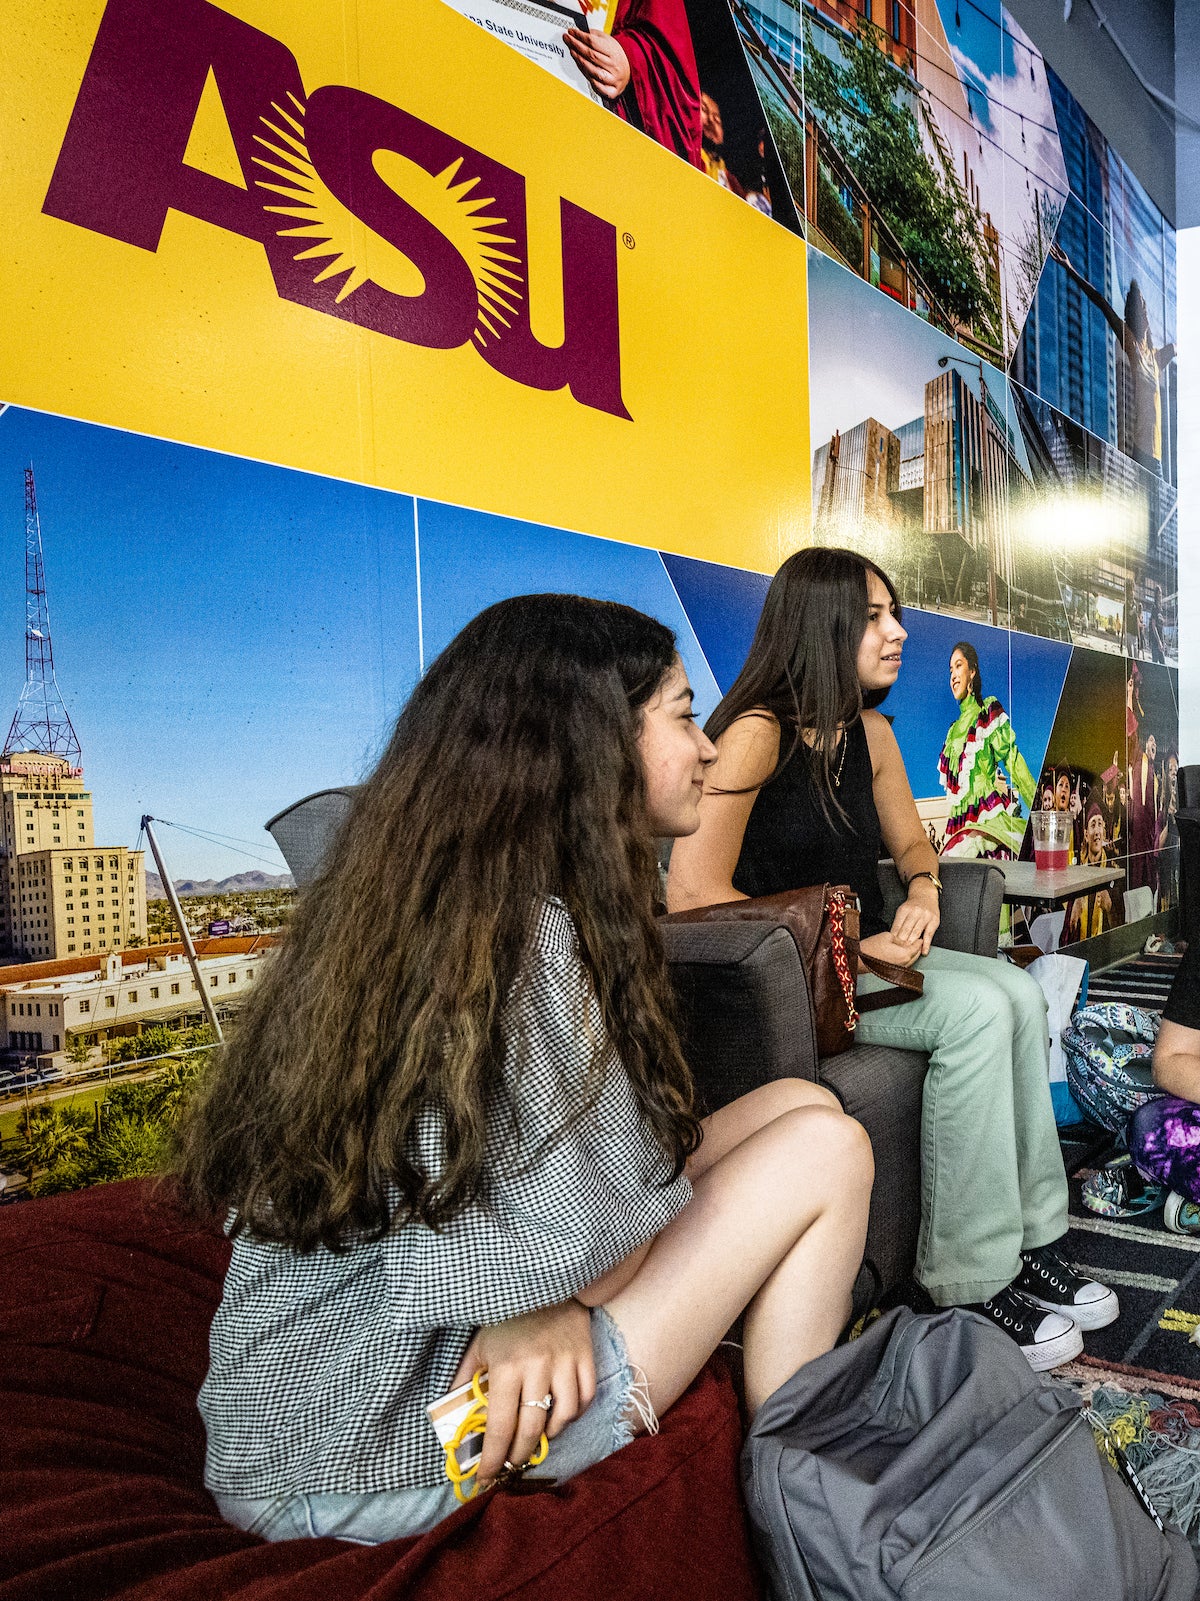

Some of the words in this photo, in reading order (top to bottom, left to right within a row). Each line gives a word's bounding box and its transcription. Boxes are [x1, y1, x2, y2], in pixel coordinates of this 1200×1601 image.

[485, 19, 514, 38] State
[516, 30, 565, 58] University
[41, 0, 635, 422] ASU
